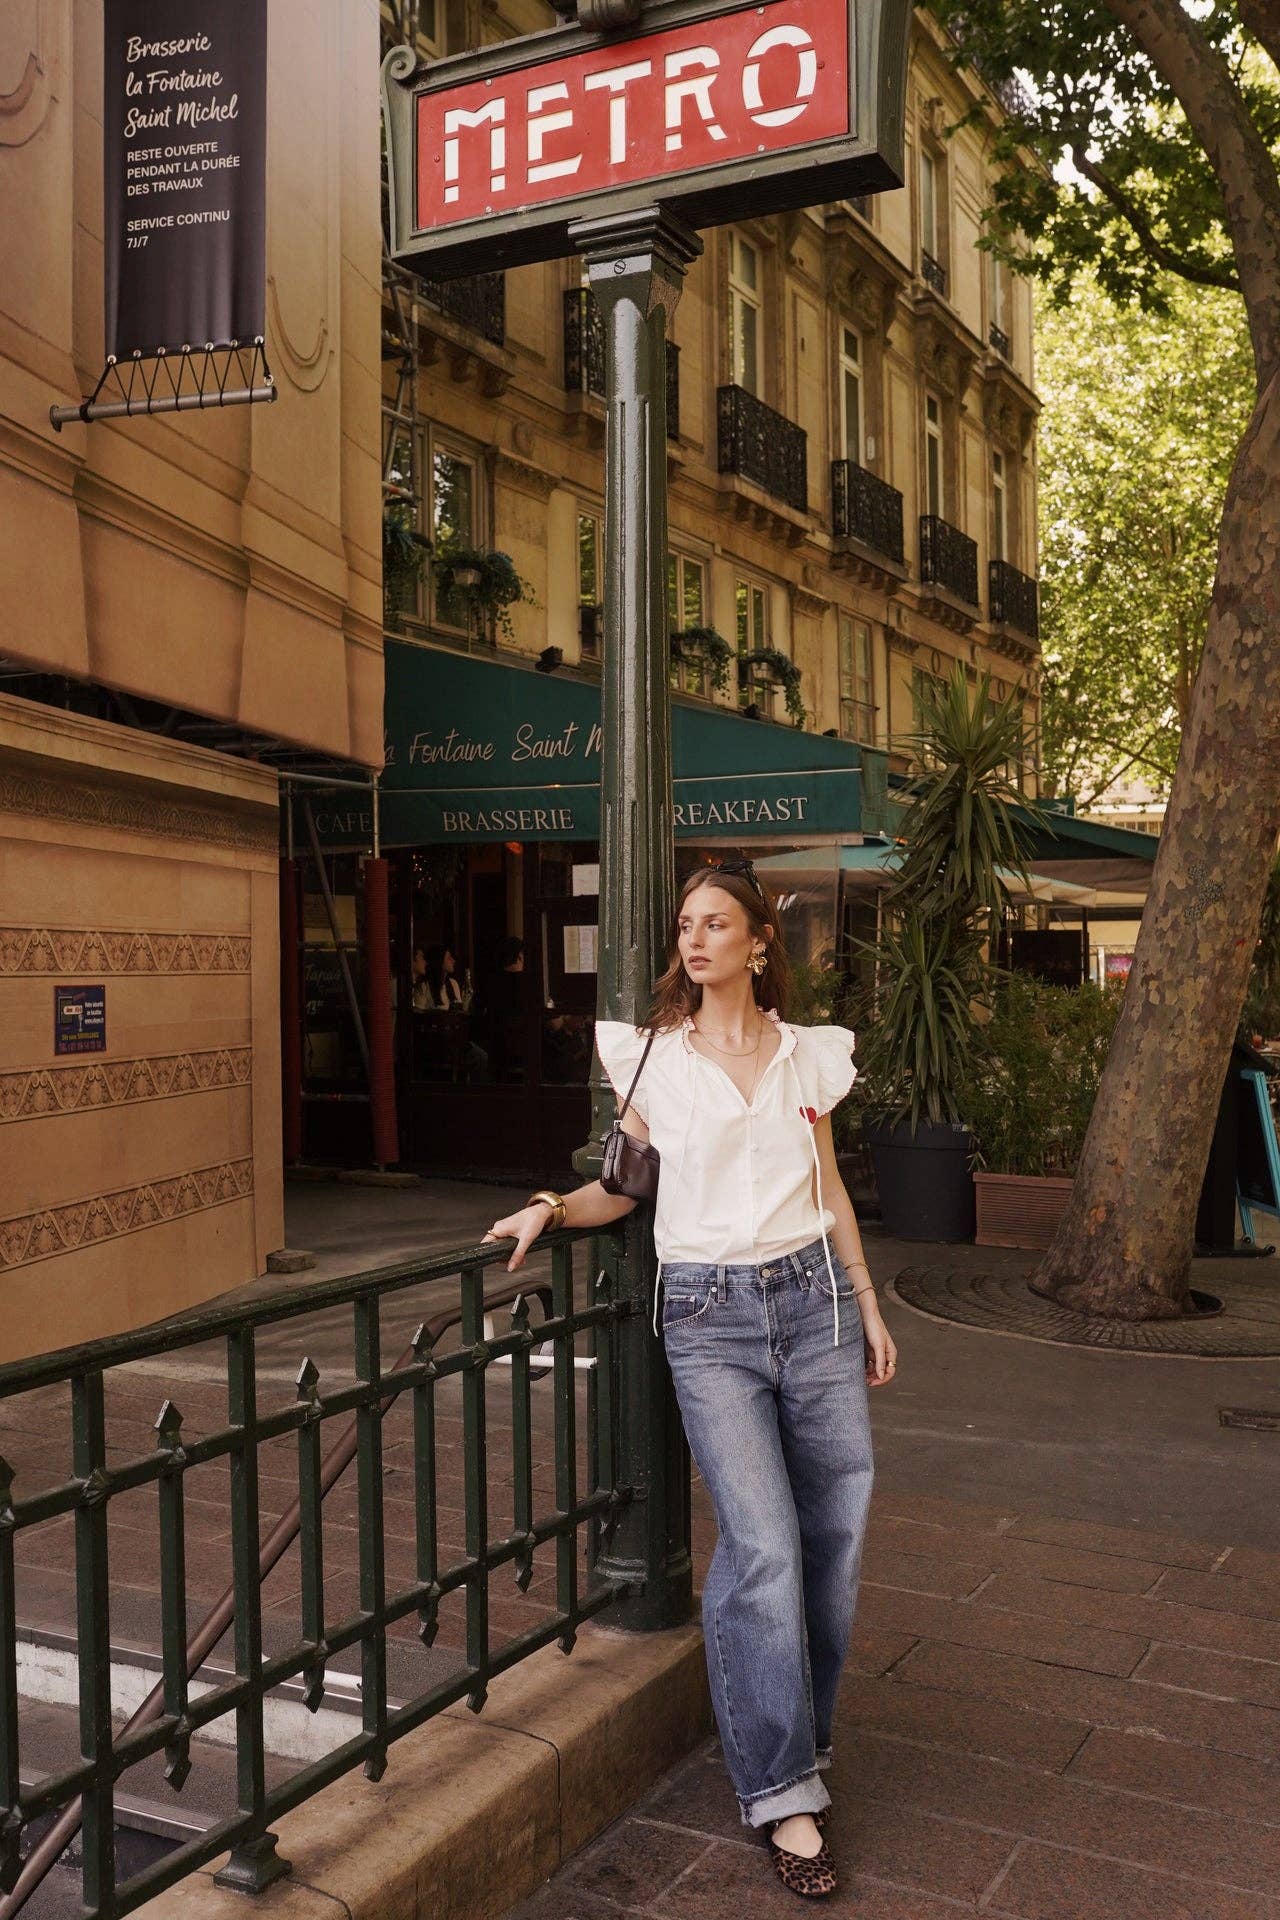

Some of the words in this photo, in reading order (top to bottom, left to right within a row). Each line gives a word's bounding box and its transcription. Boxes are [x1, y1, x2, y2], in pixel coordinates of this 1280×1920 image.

[126, 32, 212, 63] Brasserie
[125, 71, 142, 96] la
[146, 68, 223, 95] Fontaine
[124, 107, 172, 138] Saint
[176, 94, 239, 129] Michel
[444, 24, 818, 204] METRO
[127, 146, 162, 162] RESTE
[164, 141, 218, 158] OUVERTE
[127, 163, 182, 179] PENDANT
[183, 160, 199, 172] LA
[201, 155, 241, 171] DURÉE
[127, 184, 150, 196] DES
[151, 177, 204, 193] TRAVAUX
[127, 215, 174, 232] SERVICE
[176, 209, 231, 225] CONTINU
[127, 235, 149, 249] 7J/7
[409, 728, 497, 764] Fontaine
[511, 721, 579, 762] Saint
[442, 808, 575, 832] BRASSERIE
[673, 797, 808, 826] REAKFAST
